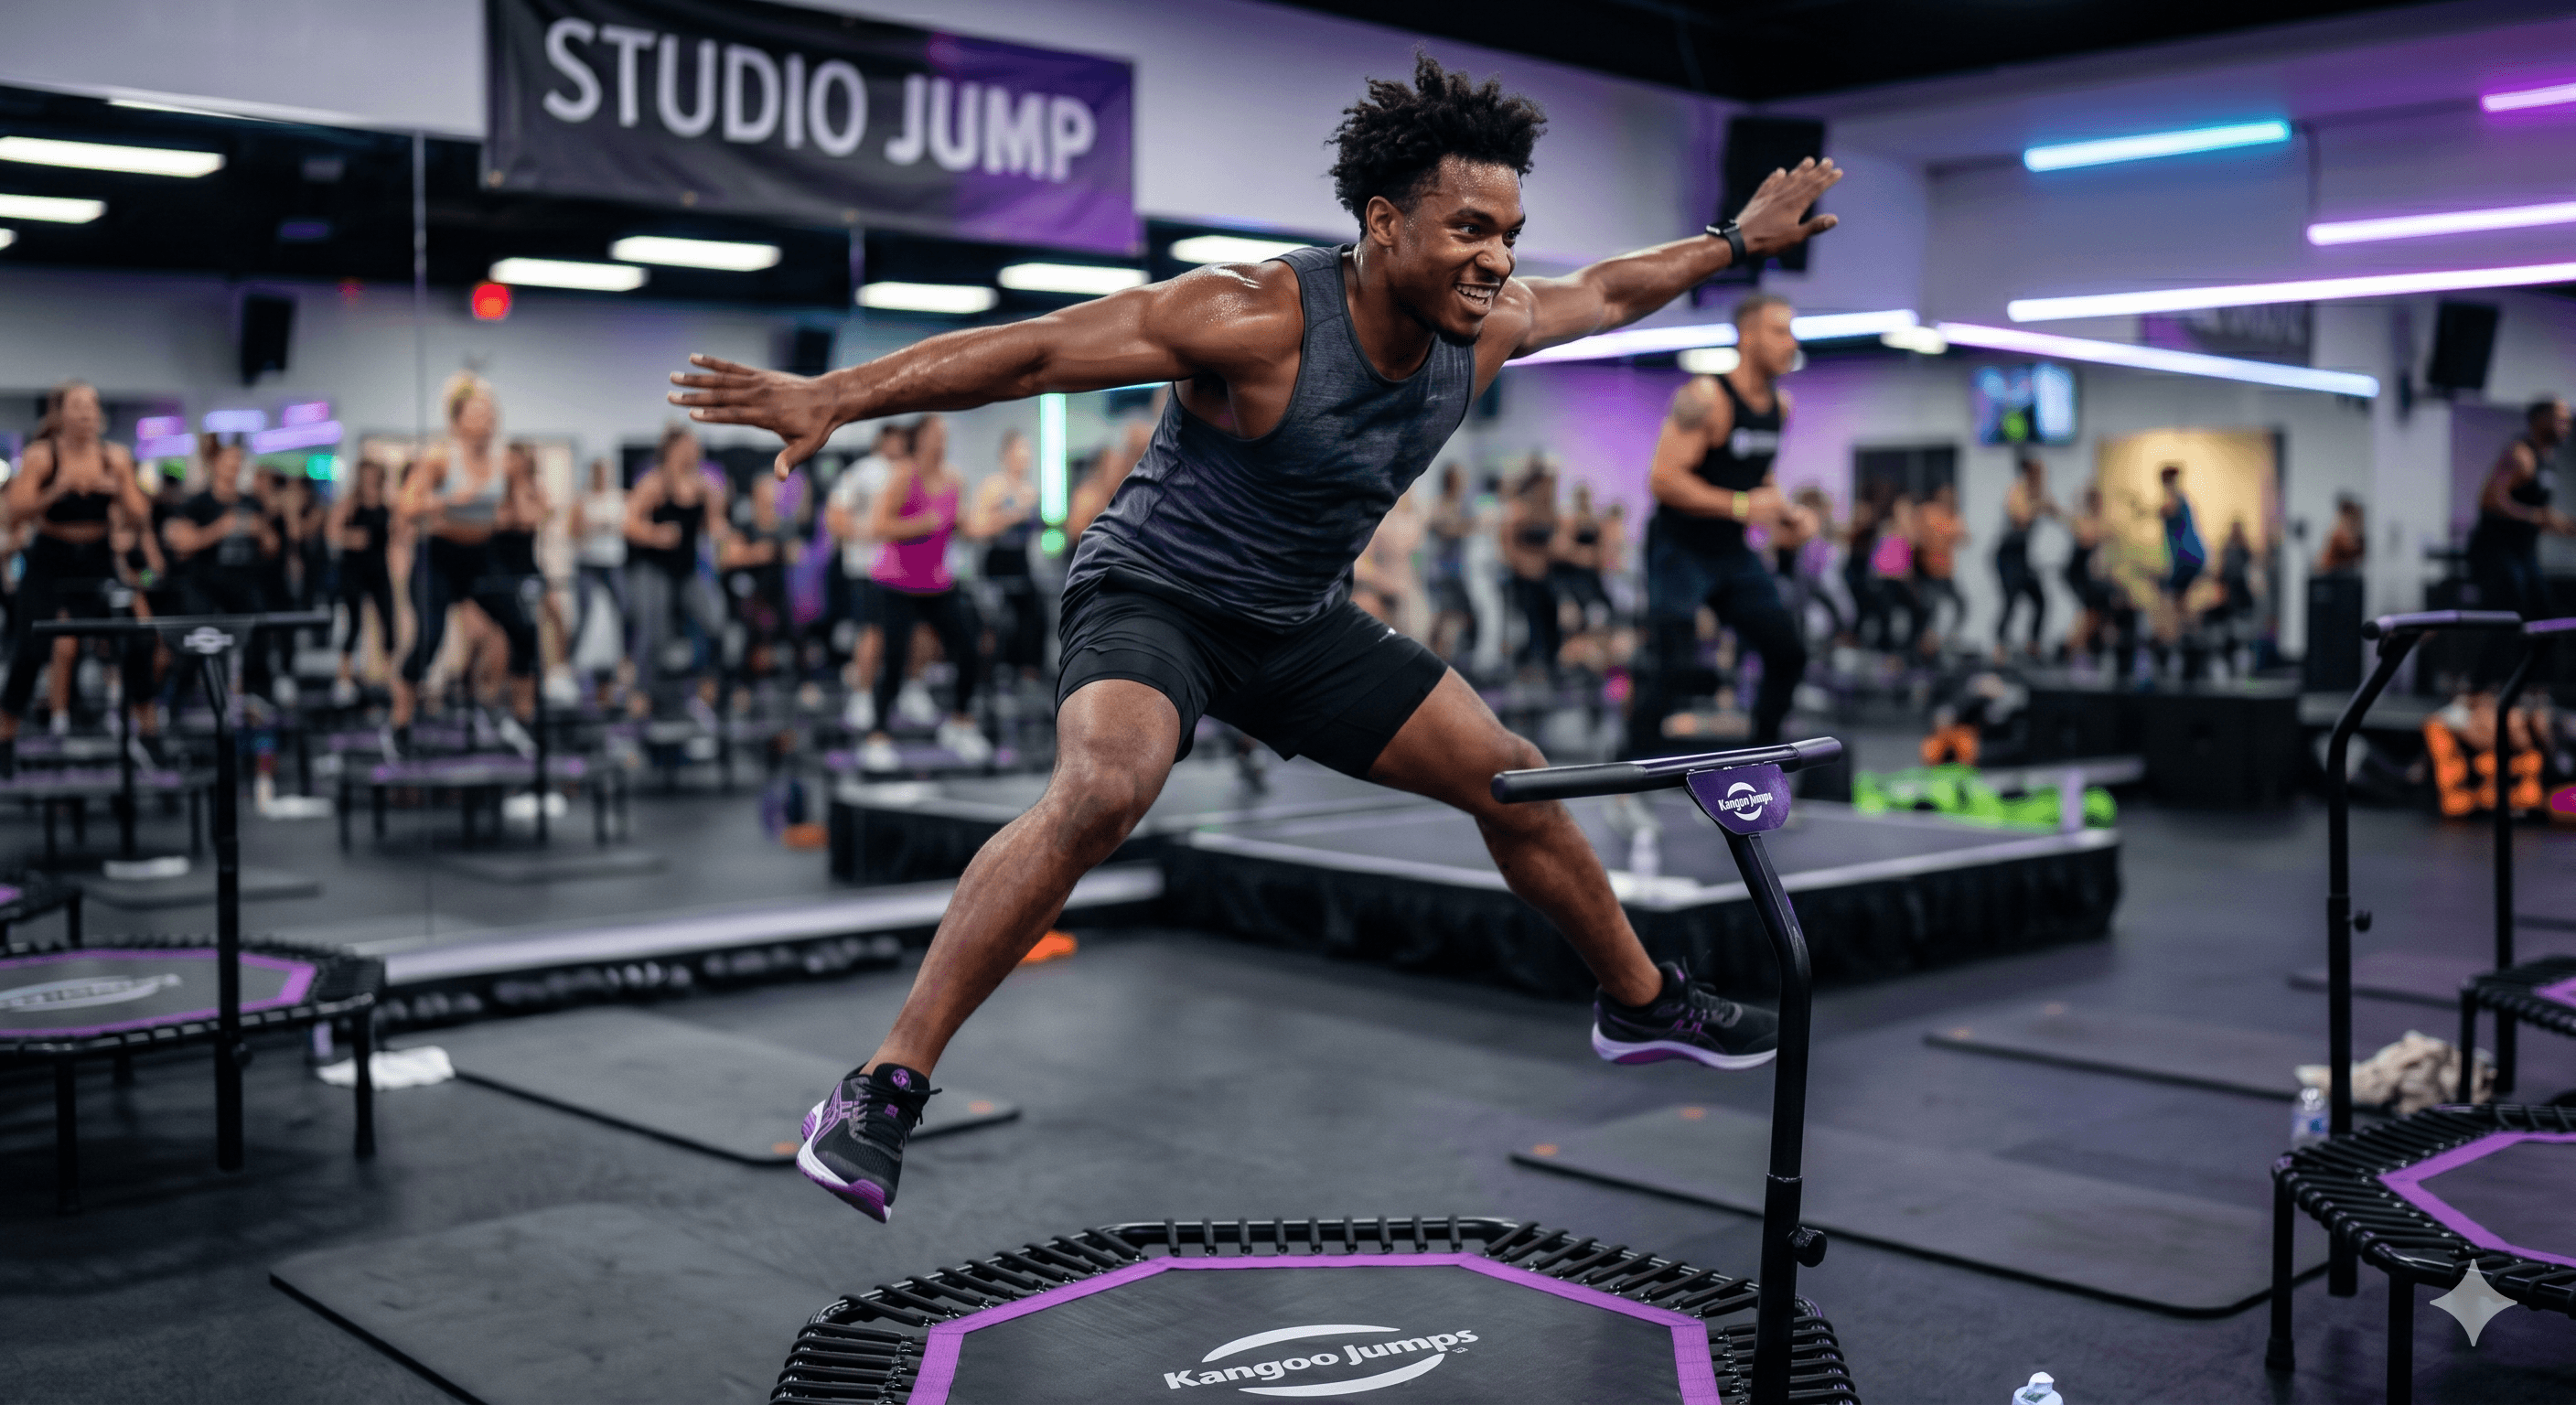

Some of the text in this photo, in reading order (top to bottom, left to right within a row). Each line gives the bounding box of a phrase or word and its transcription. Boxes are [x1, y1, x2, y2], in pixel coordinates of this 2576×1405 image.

[543, 17, 1096, 182] STUDIO JUMP
[1164, 1330, 1478, 1389] Kangoo Jumps
